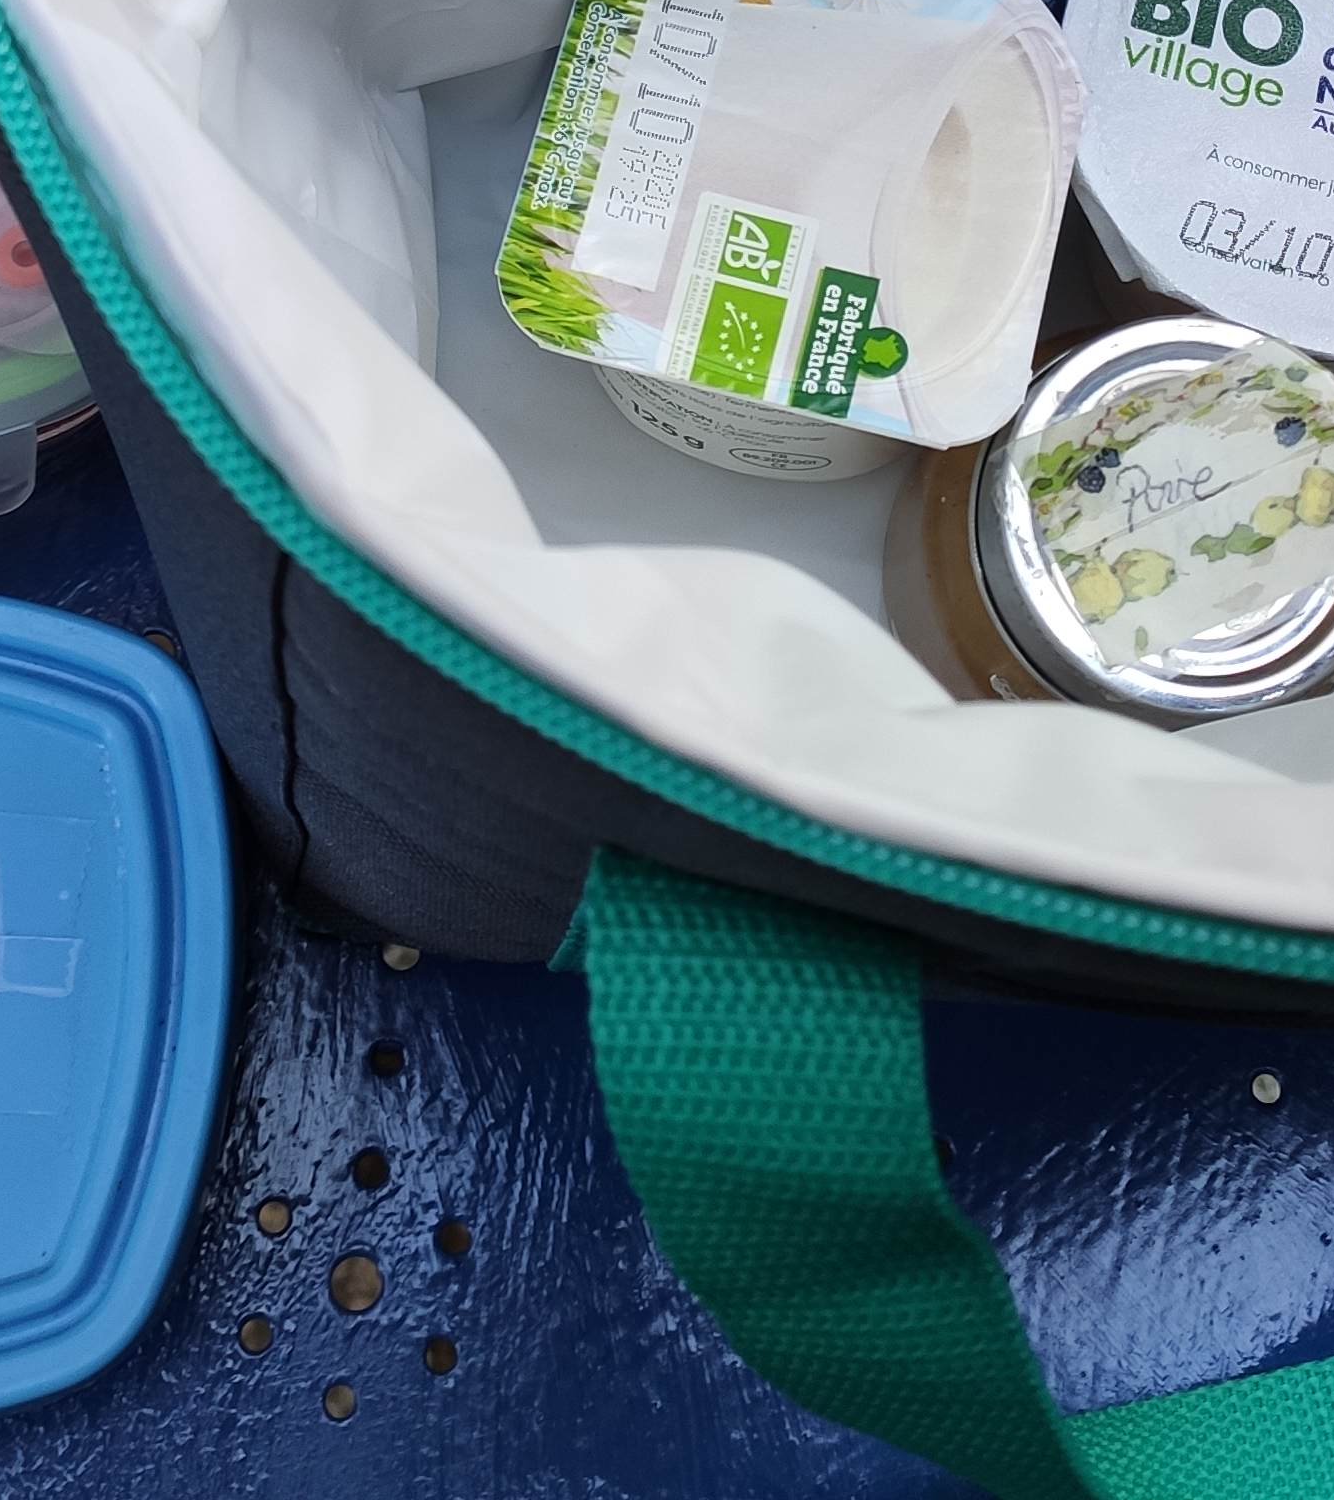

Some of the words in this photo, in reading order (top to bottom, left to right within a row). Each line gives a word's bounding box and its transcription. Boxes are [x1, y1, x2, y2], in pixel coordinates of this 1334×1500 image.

[564, 2, 609, 115] Conservation
[580, 26, 618, 123] consommer
[1124, 36, 1284, 107] village
[1223, 153, 1325, 192] consommer
[724, 213, 771, 270] AB
[1184, 241, 1294, 279] Conservation
[822, 284, 843, 313] en
[801, 317, 838, 395] France
[826, 293, 867, 396] Fabriqué
[630, 399, 679, 436] 125
[683, 435, 705, 450] g
